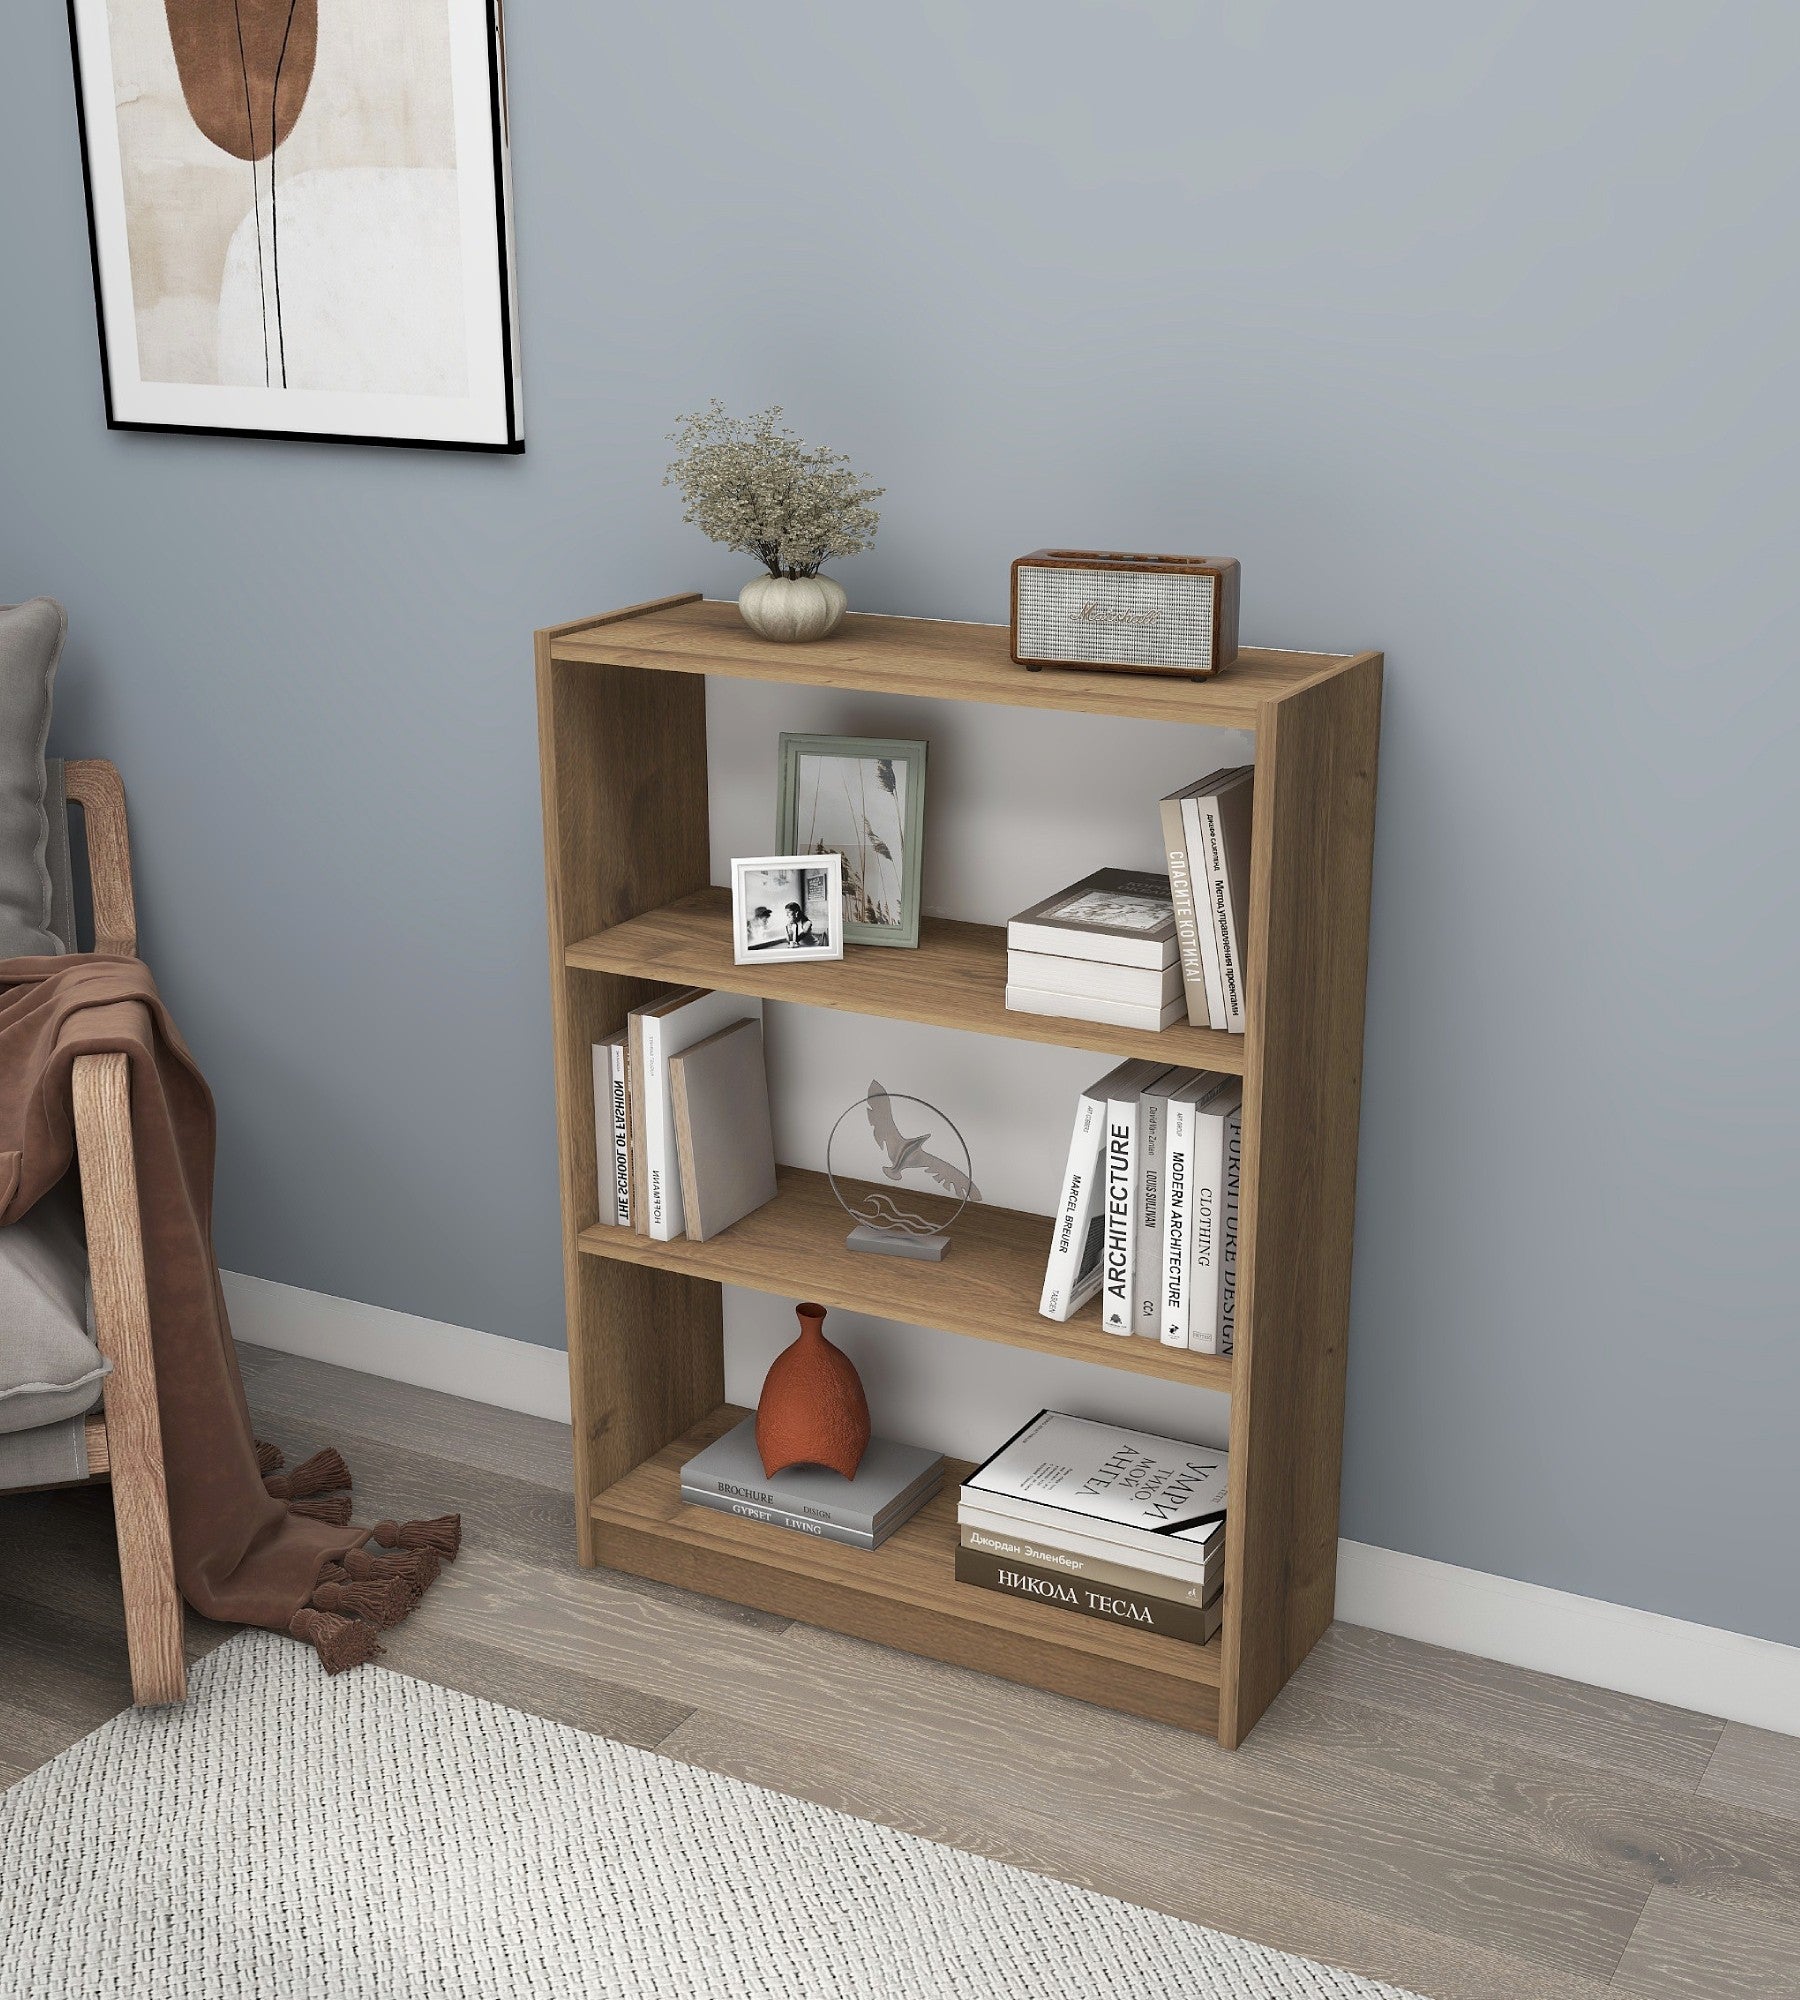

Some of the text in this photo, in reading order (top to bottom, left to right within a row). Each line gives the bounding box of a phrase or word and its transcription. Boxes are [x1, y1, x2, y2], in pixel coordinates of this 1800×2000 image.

[1070, 601, 1163, 624] Marshall
[1169, 851, 1201, 983] СПАСИТЕ КОТИКА!
[1214, 880, 1225, 910] Метод
[1227, 967, 1239, 1016] проектами
[1058, 1174, 1082, 1254] MARCEL BREUER
[1108, 1123, 1130, 1300] ARCHITECTURE
[1145, 1170, 1158, 1229] LOUIS SULLIVAN
[1198, 1187, 1213, 1267] CLOTHING
[1168, 1151, 1185, 1308] MODERN ARCHITECTURE
[1143, 1300, 1154, 1317] CCA
[1075, 1444, 1140, 1496] АНГЕЛ
[1119, 1457, 1157, 1488] МОЙ
[1130, 1469, 1175, 1501] ТИХО,
[1143, 1462, 1218, 1520] УМРИ
[717, 1481, 831, 1520] BROCHURE DISIGN
[732, 1504, 822, 1536] GYPSET LIVING
[970, 1532, 1084, 1571] Джордан Элленберг
[997, 1568, 1155, 1625] НИКОЛА ТЕСЛА
